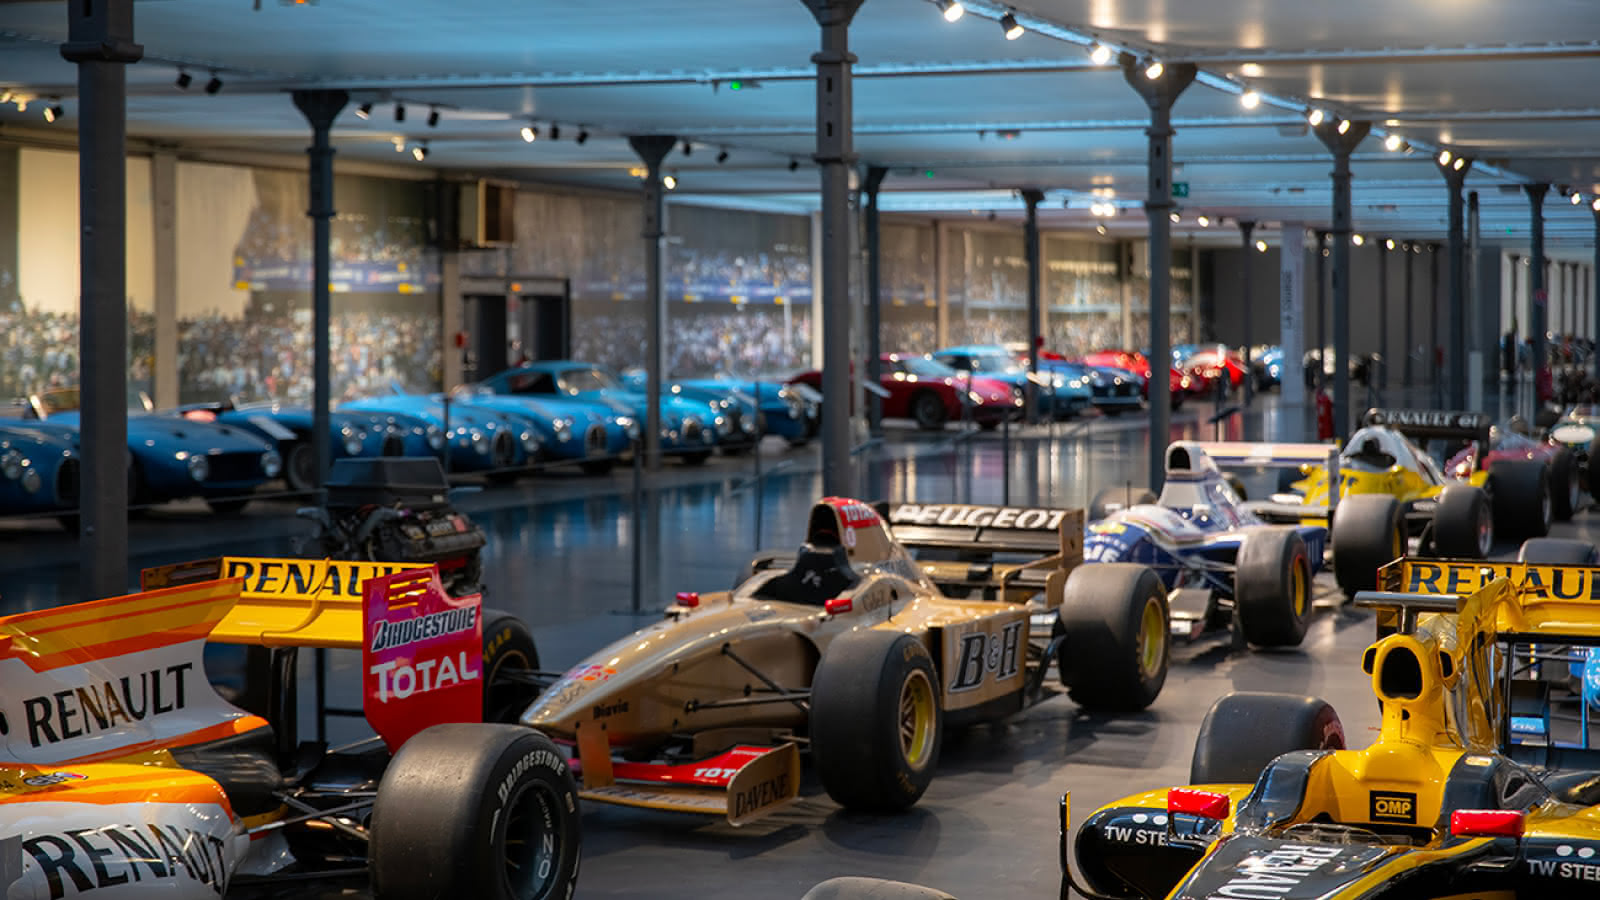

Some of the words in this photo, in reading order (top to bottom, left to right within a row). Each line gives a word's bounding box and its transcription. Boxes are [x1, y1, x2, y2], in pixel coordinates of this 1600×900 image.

[891, 504, 1067, 530] PEUGEOT
[371, 605, 476, 653] BRIDGESTONE
[949, 620, 1024, 692] B&H
[370, 651, 478, 703] TOTAL
[24, 662, 193, 748] RENAULT
[497, 750, 565, 807] BRIDGESTONE
[694, 767, 737, 778] TOT
[1376, 800, 1411, 814] OMP
[1104, 825, 1132, 842] TW
[1135, 829, 1169, 846] STE
[1527, 859, 1557, 877] TW
